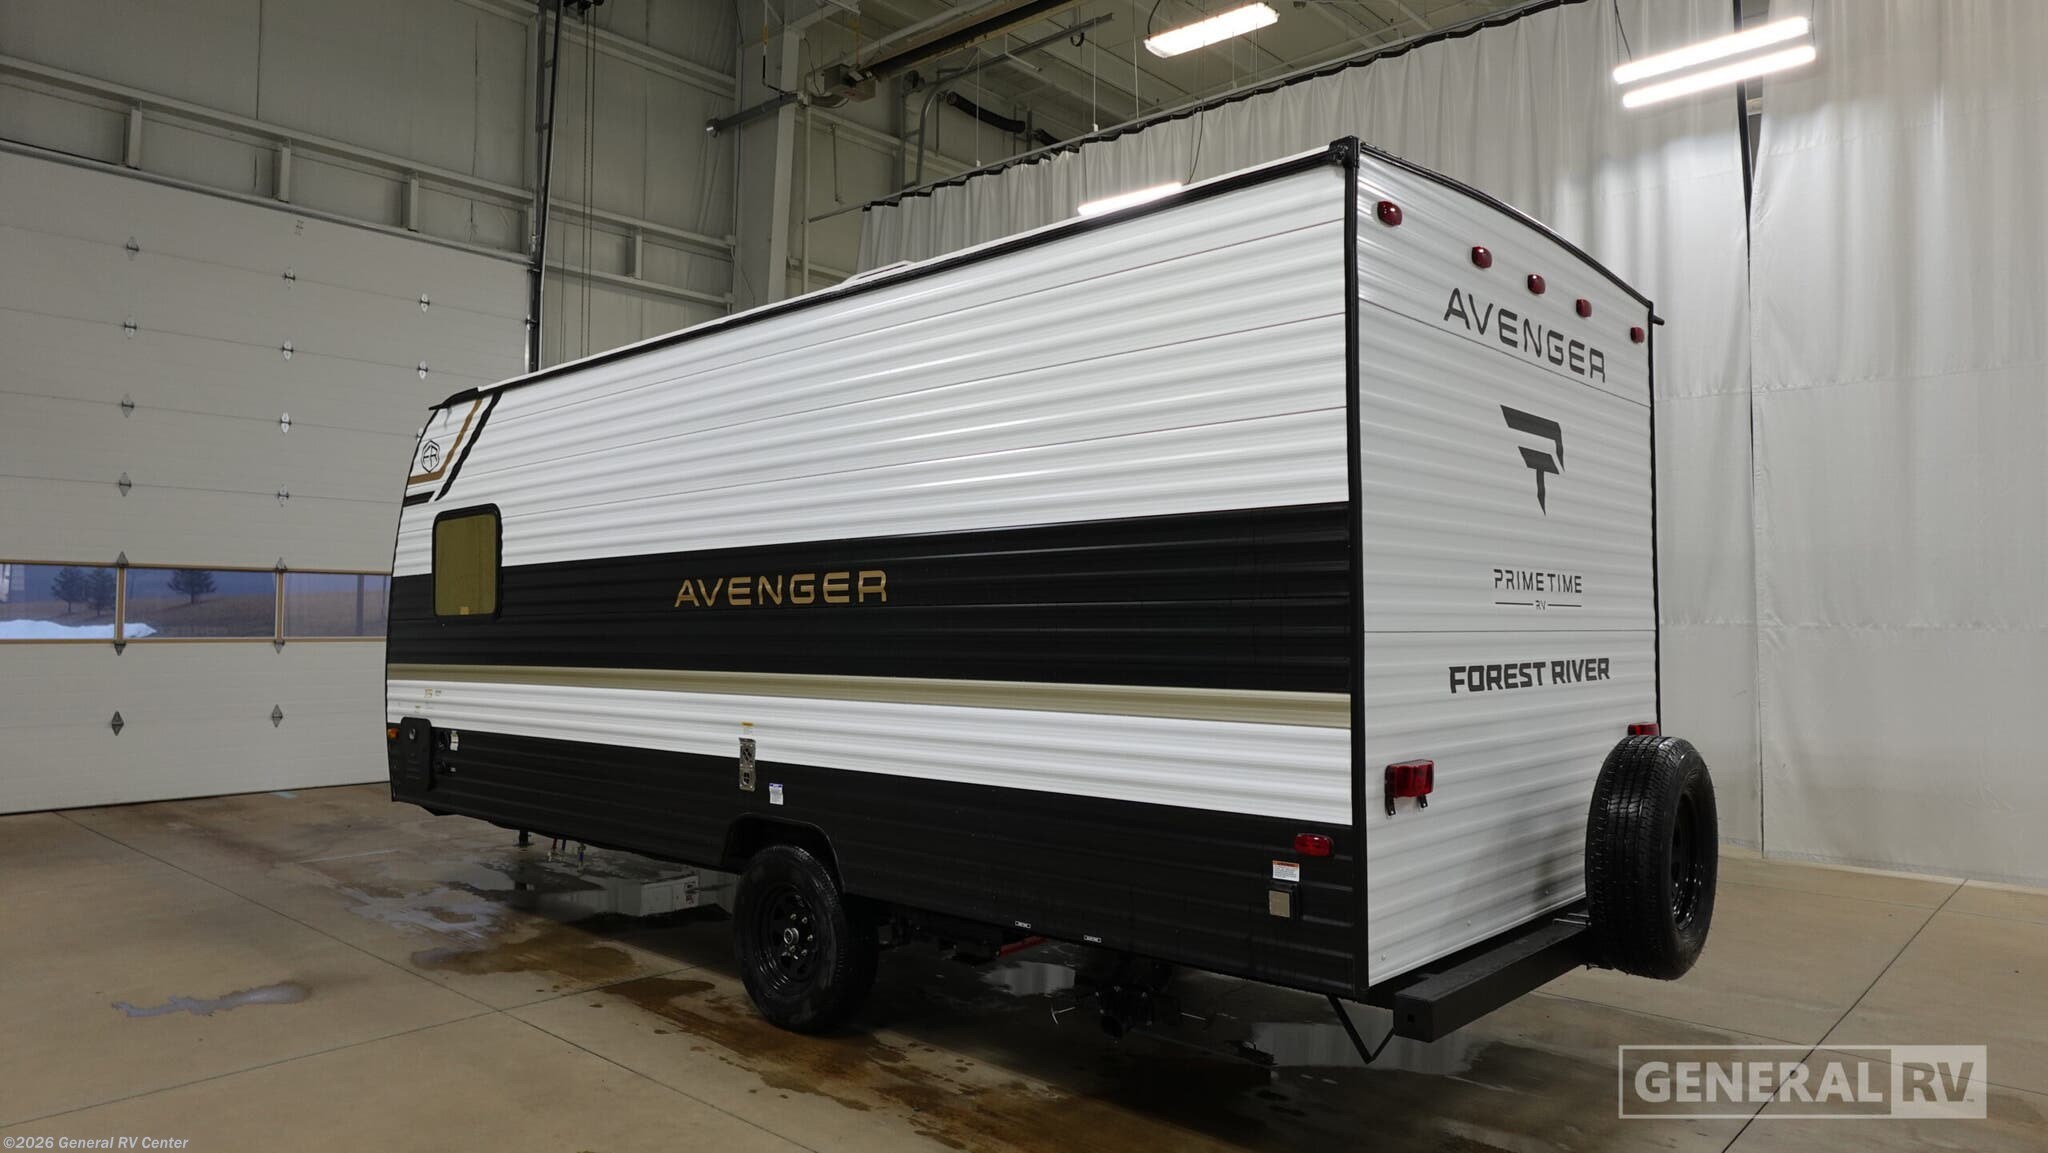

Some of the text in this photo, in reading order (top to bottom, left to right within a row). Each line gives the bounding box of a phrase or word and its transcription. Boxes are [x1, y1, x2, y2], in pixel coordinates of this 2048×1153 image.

[1443, 288, 1606, 383] AVENGER
[674, 569, 888, 607] AVENGER
[1535, 600, 1547, 611] RV
[1448, 658, 1610, 693] FOREST RIVER
